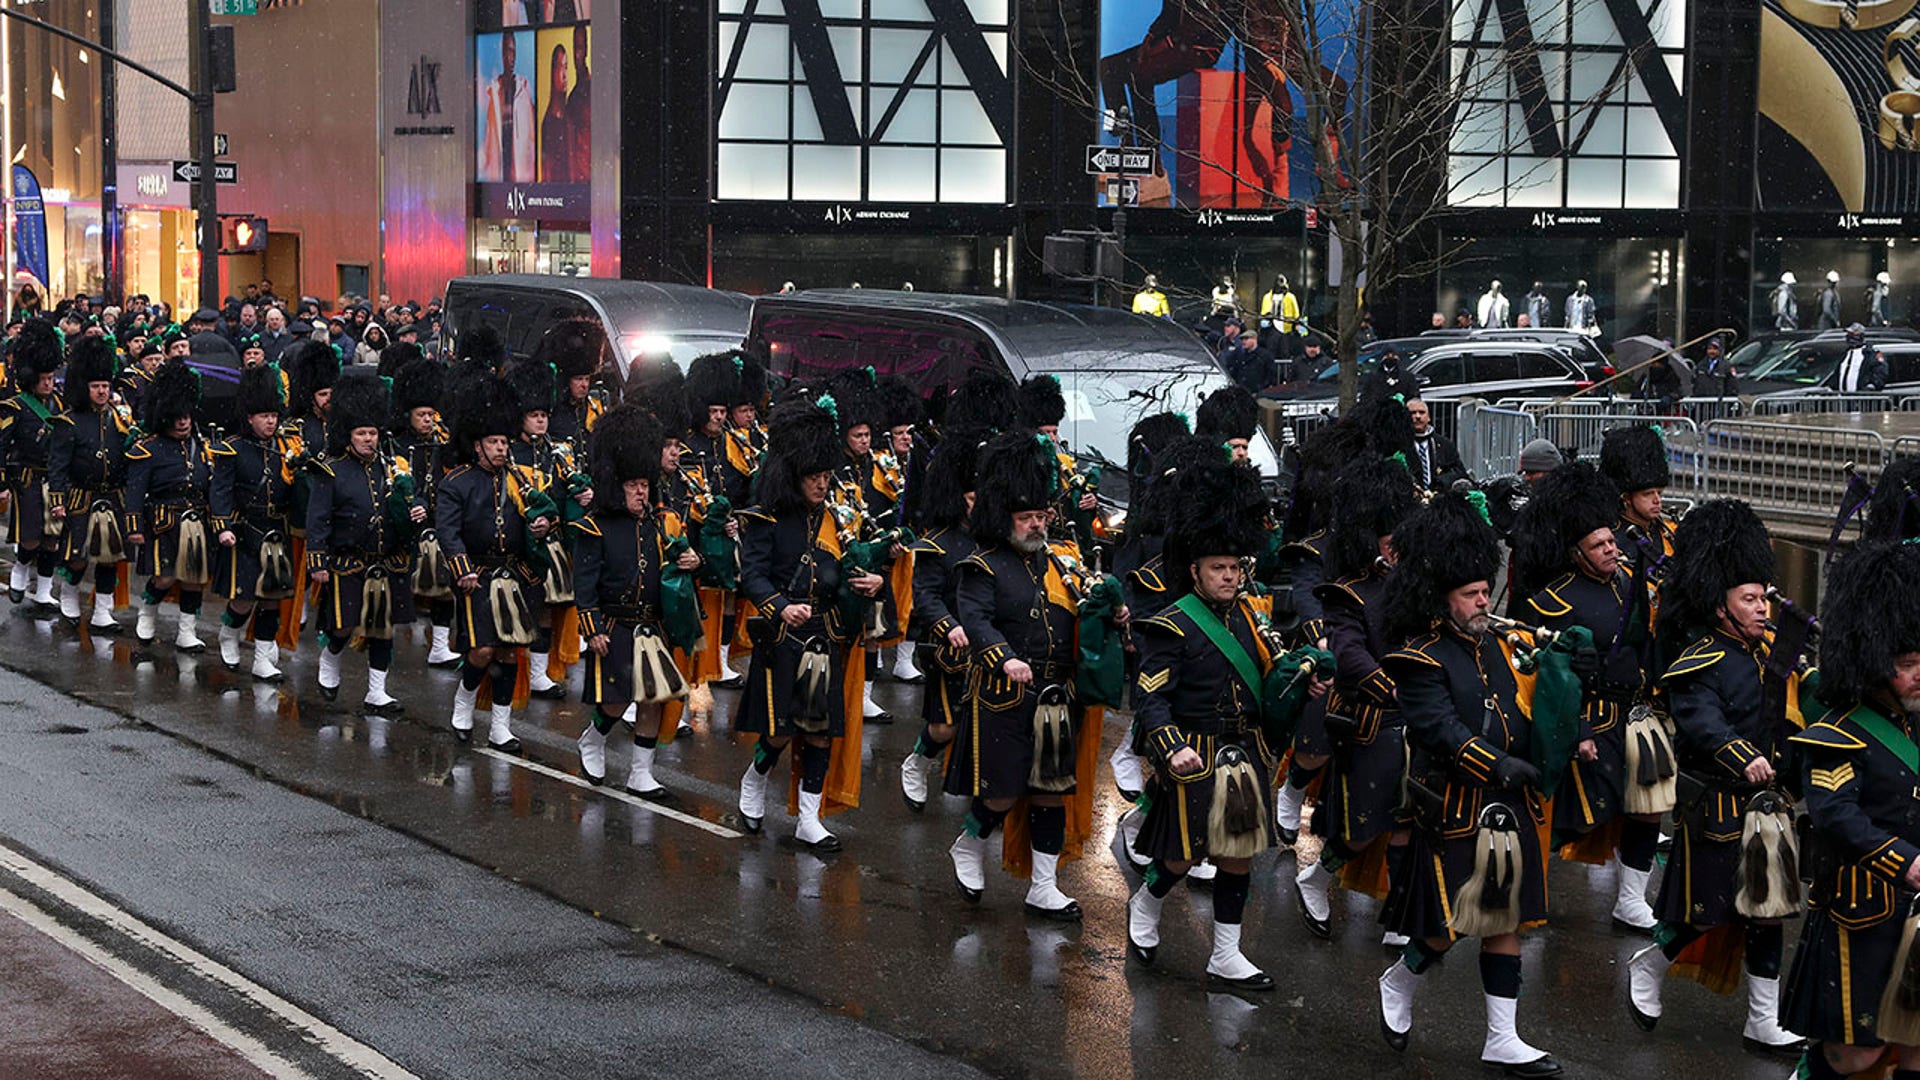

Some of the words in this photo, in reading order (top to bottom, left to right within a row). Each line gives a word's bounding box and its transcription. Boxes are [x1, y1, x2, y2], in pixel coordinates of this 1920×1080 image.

[234, 0, 243, 12] 51
[1097, 154, 1116, 166] ONE
[1125, 155, 1146, 166] WAY
[16, 200, 40, 210] NYPD
